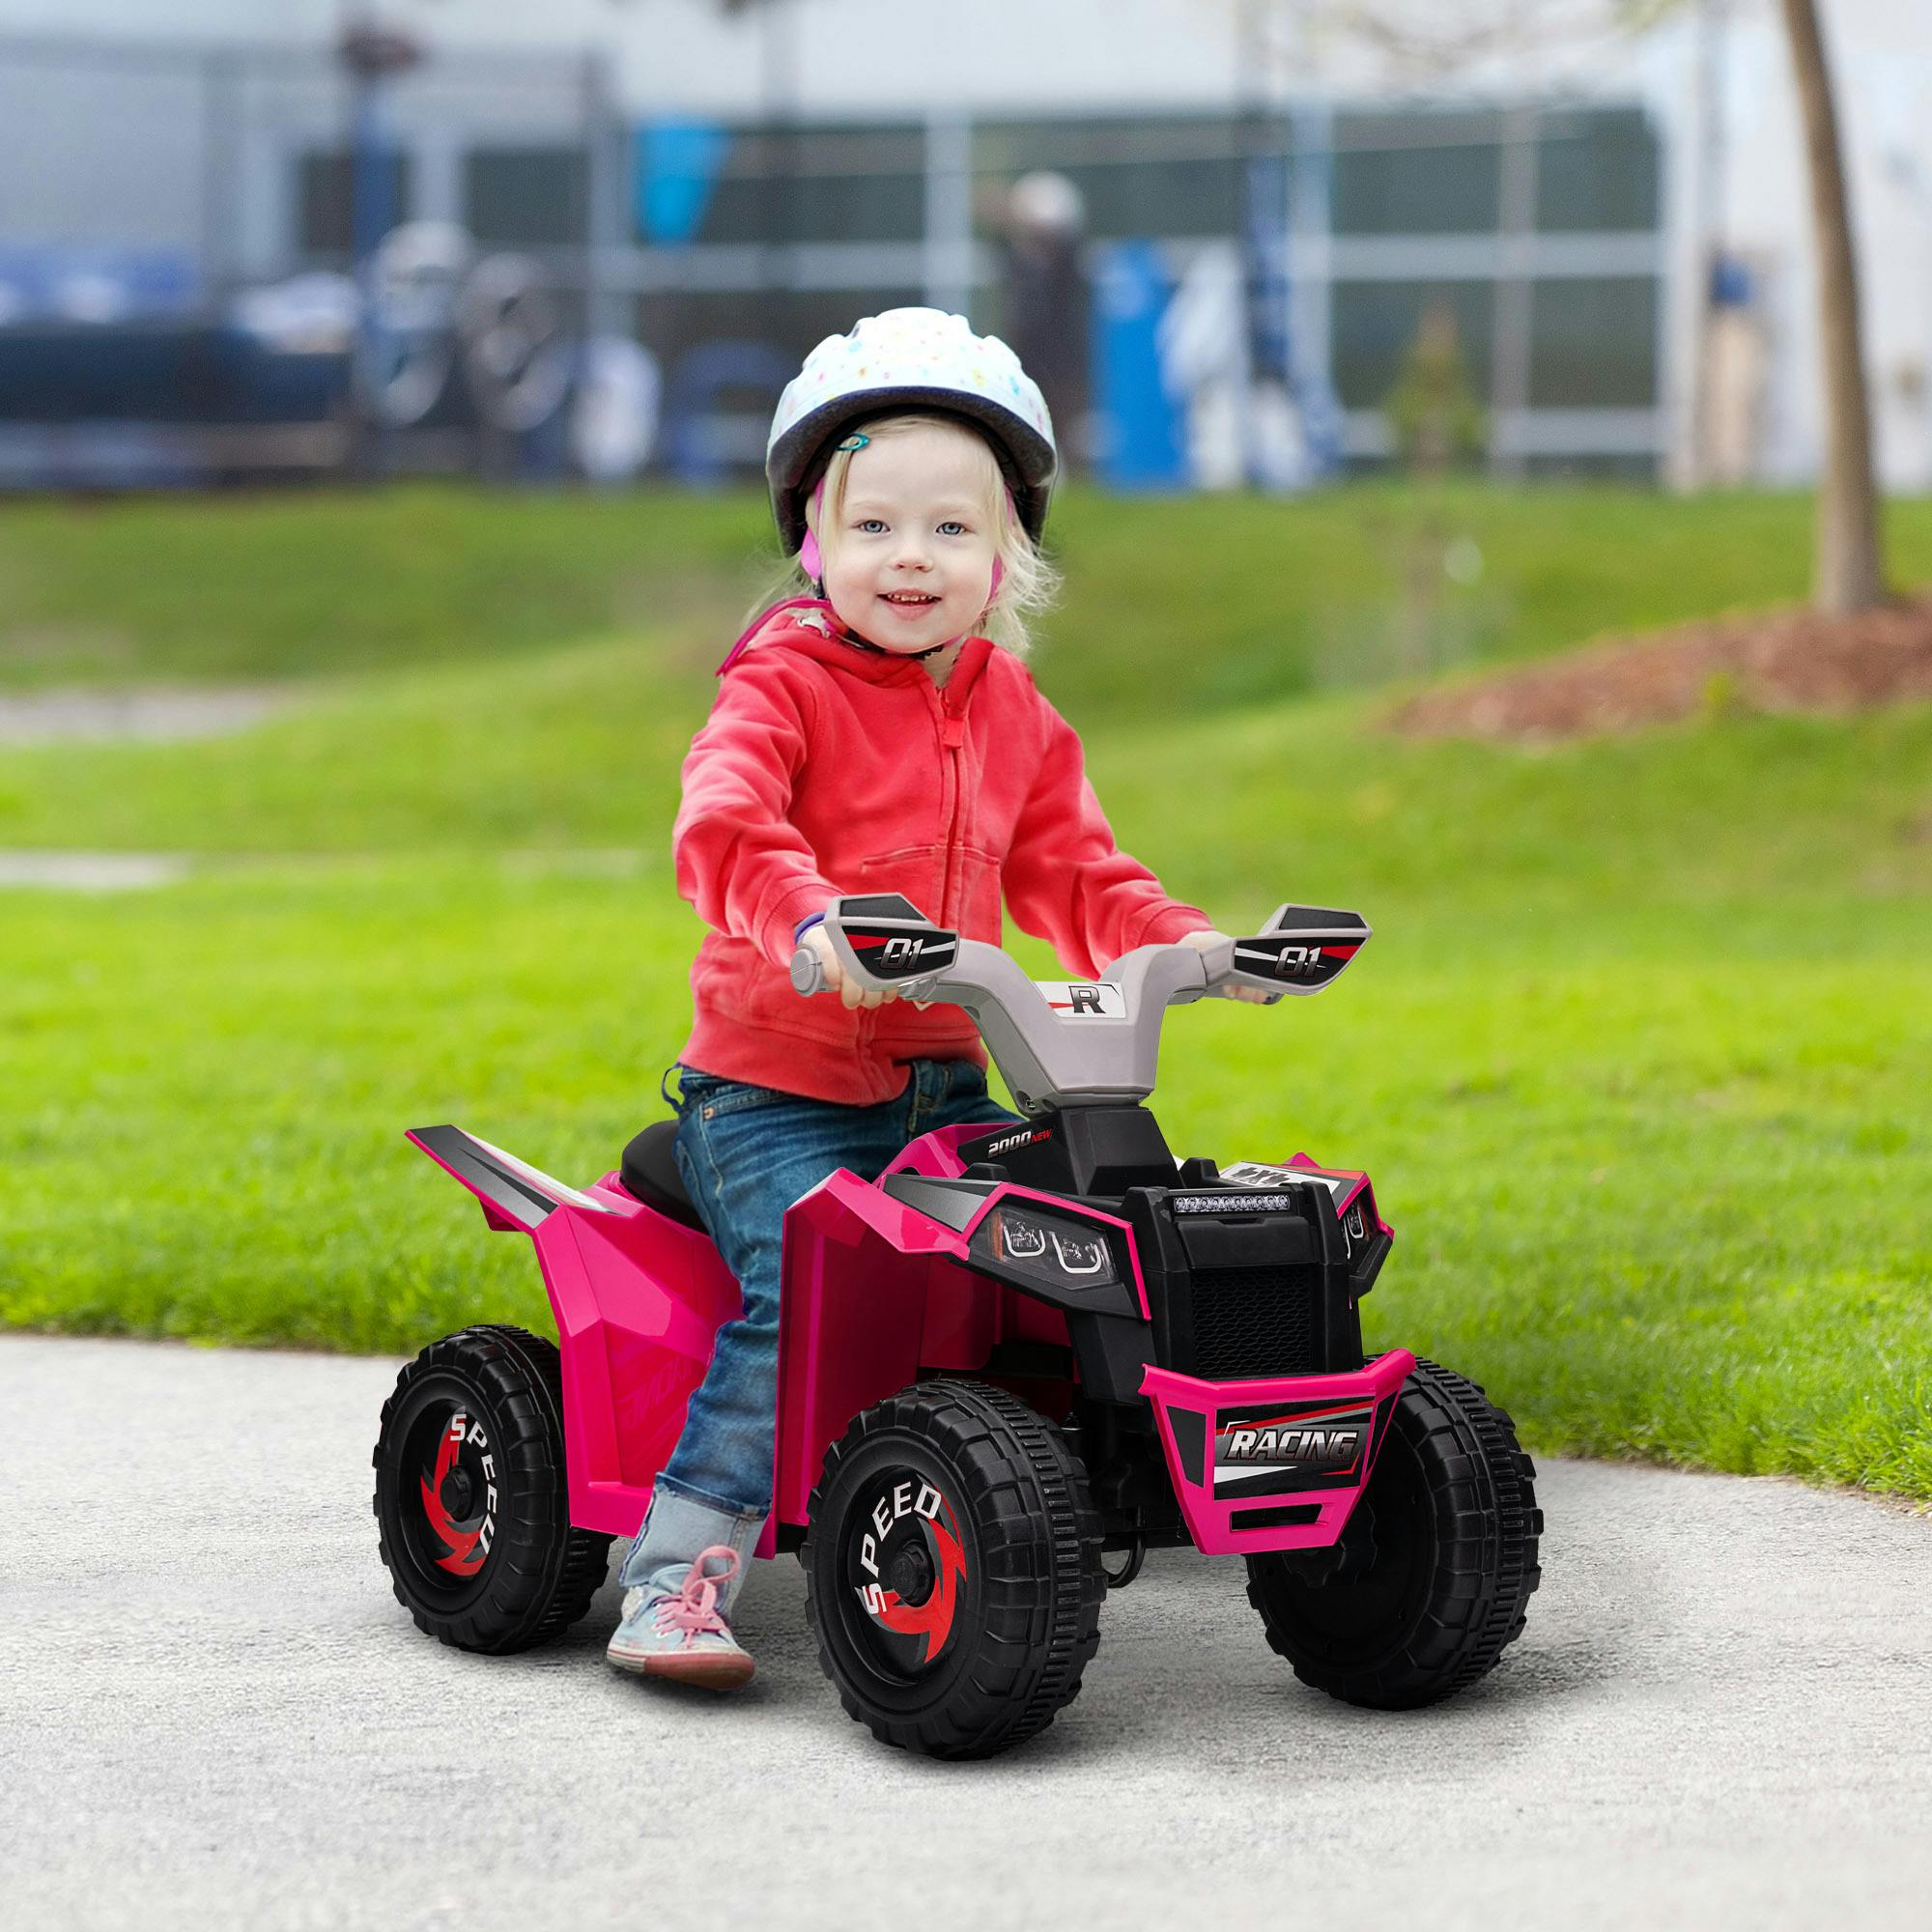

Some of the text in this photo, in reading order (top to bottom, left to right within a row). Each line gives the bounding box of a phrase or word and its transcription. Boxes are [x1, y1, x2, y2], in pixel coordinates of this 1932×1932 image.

[880, 938, 923, 969] 01
[1275, 947, 1321, 977] 01
[1068, 985, 1106, 1014] R
[987, 1130, 1032, 1159] 2000
[1224, 1429, 1358, 1462] RACING
[860, 1481, 942, 1615] SPEED
